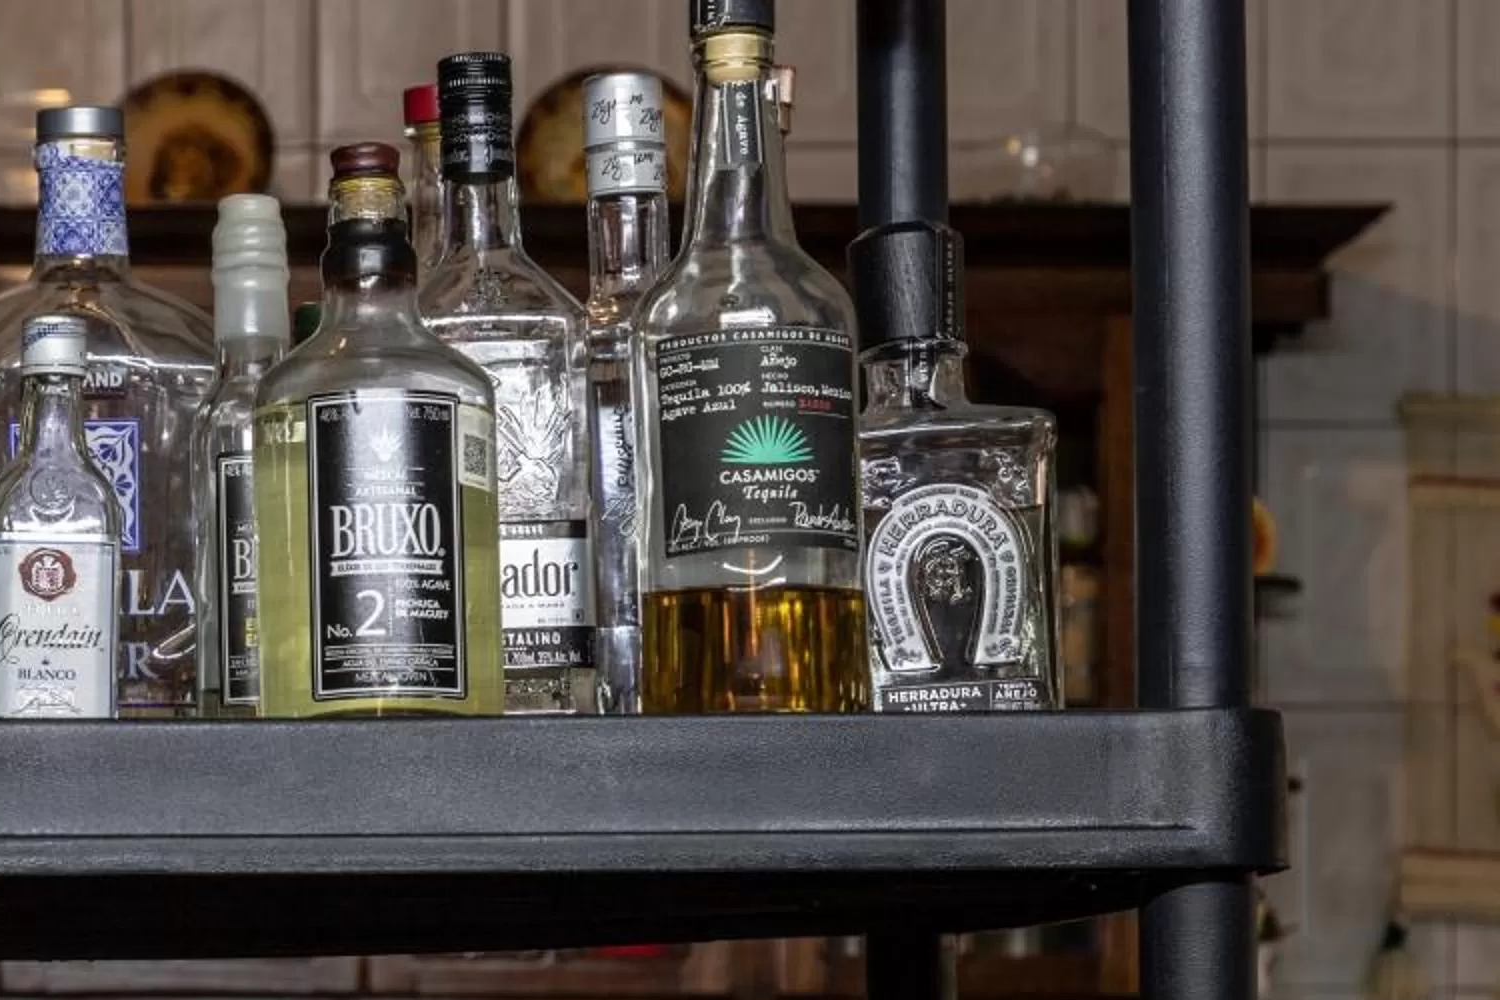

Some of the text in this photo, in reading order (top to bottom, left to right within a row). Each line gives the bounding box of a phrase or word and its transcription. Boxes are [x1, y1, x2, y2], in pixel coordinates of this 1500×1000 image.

[733, 330, 804, 340] CASAMIGOS
[717, 381, 752, 397] 100%
[761, 381, 820, 396] Jalisco,
[720, 468, 816, 484] CASAMIGOS
[743, 484, 798, 503] Tequila
[329, 503, 440, 558] BRUXO
[881, 499, 1010, 557] HERRADURA
[502, 548, 579, 599] ador
[421, 579, 451, 591] AGAVE
[327, 589, 386, 639] No. 2
[499, 631, 561, 646] TALINO
[17, 668, 77, 681] BLANCO
[888, 687, 981, 703] HERRADURA
